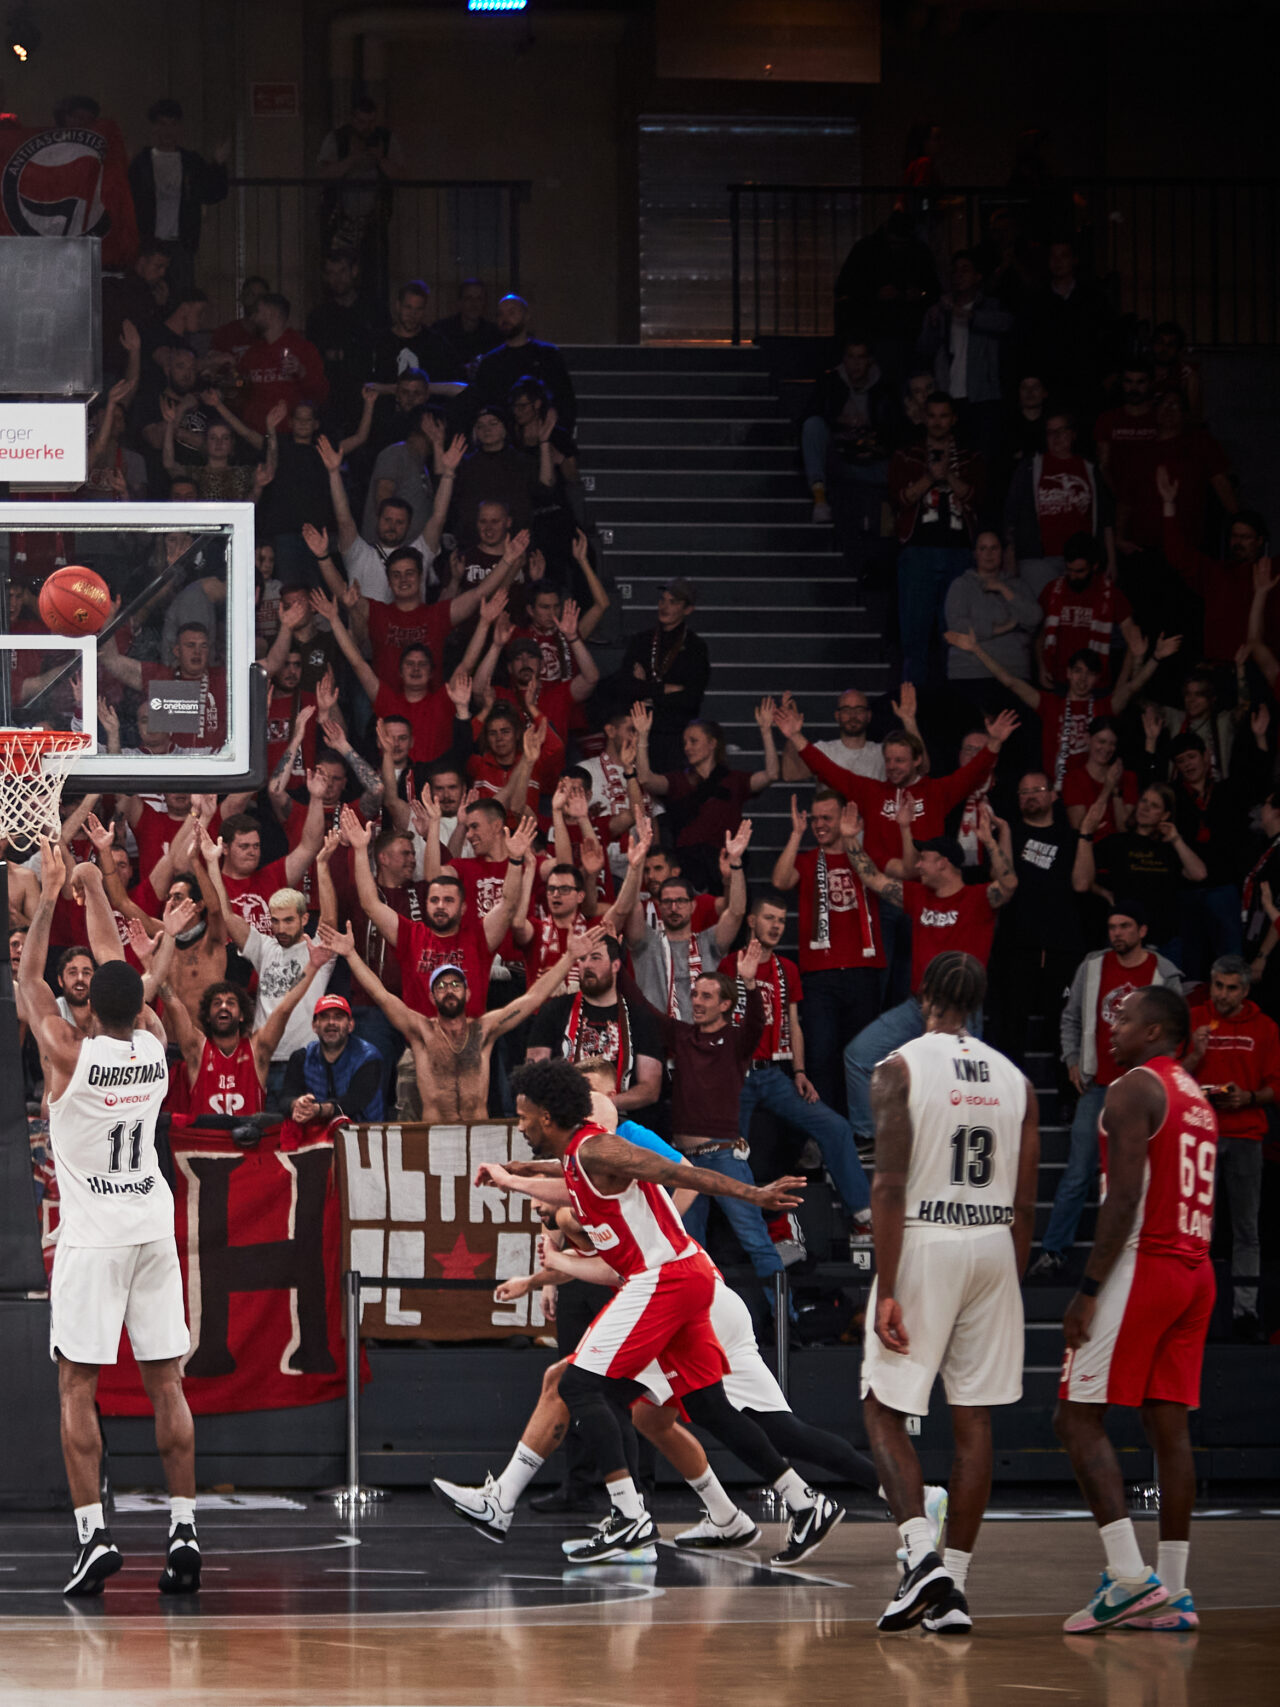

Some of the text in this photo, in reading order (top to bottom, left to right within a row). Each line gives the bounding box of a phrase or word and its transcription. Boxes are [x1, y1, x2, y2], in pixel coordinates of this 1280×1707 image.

[8, 131, 105, 176] ANTIFASCHISTIS
[965, 1095, 1000, 1106] EOLIA
[108, 1119, 144, 1173] 11
[950, 1124, 996, 1188] 13
[1179, 1131, 1217, 1206] 69
